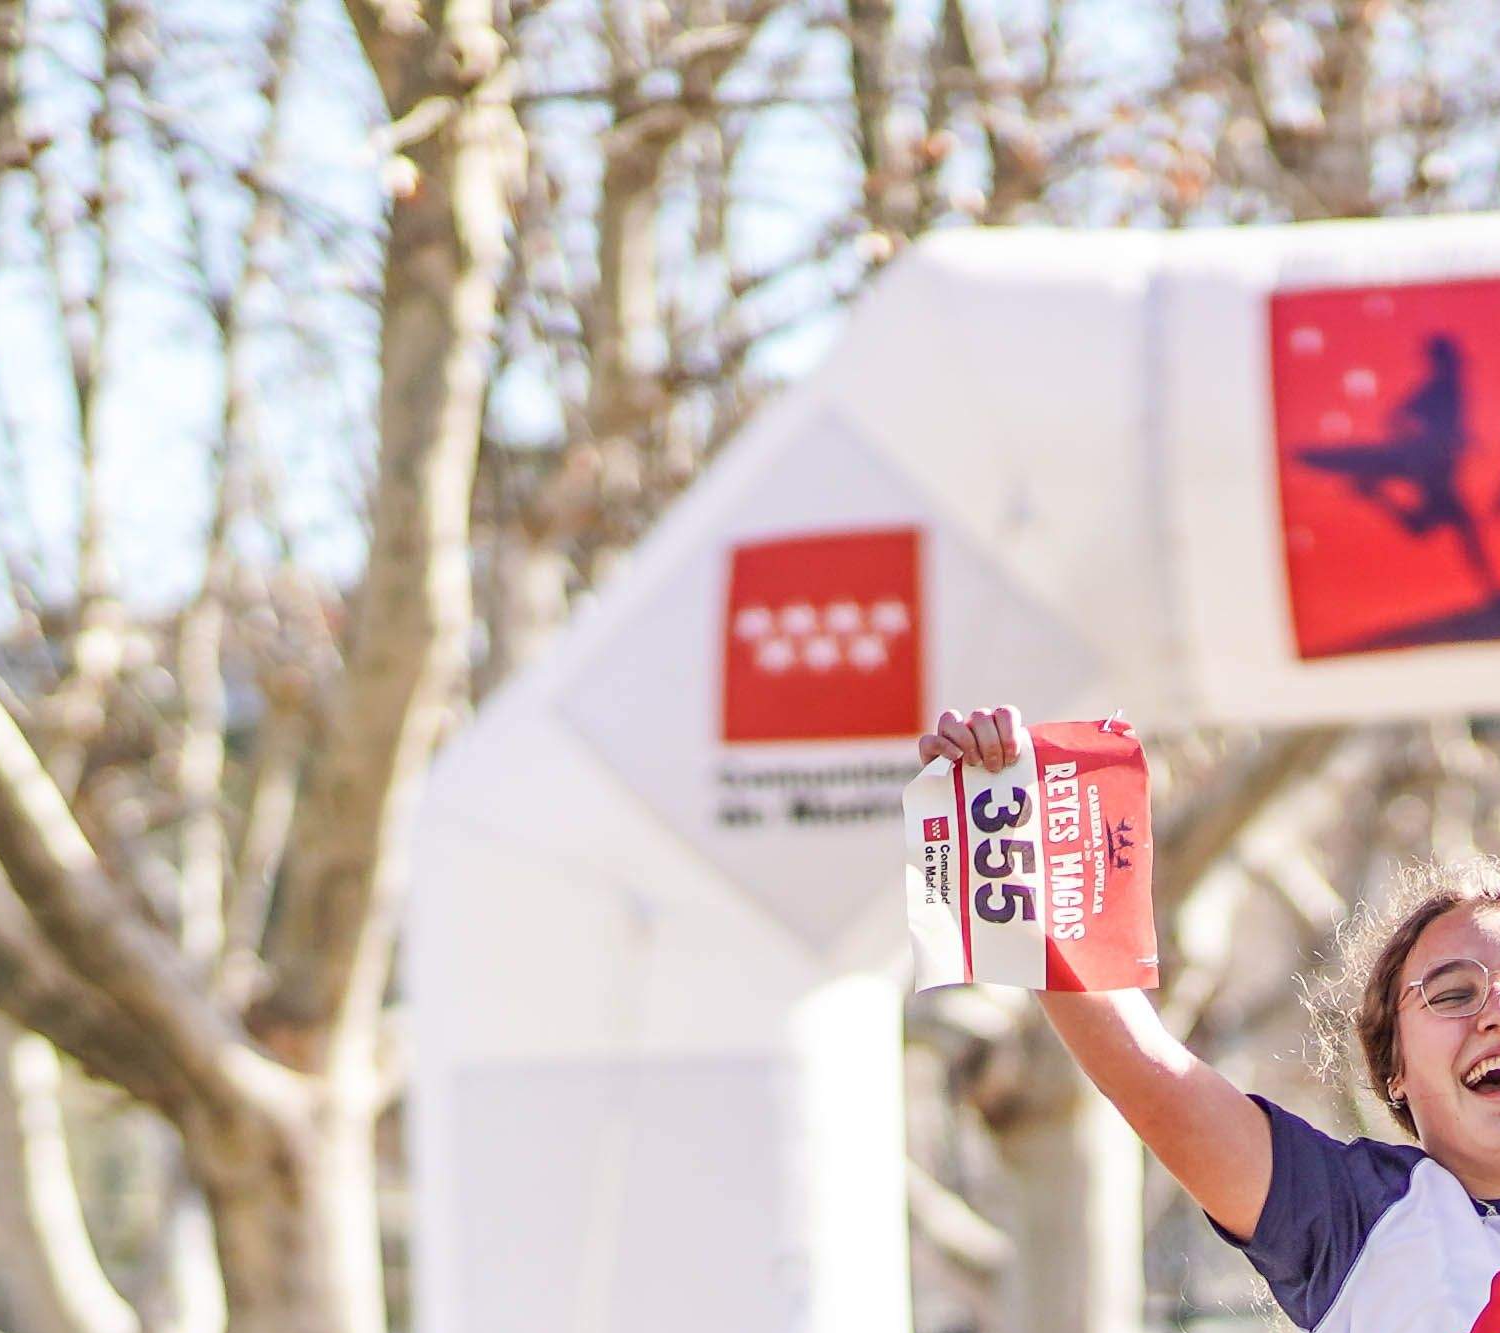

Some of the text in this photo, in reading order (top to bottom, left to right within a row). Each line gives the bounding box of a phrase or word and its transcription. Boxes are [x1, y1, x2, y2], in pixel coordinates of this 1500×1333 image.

[925, 846, 936, 862] de
[940, 844, 951, 904] Comunidad
[971, 786, 1037, 923] 355
[1044, 761, 1086, 941] REYES MAGOS
